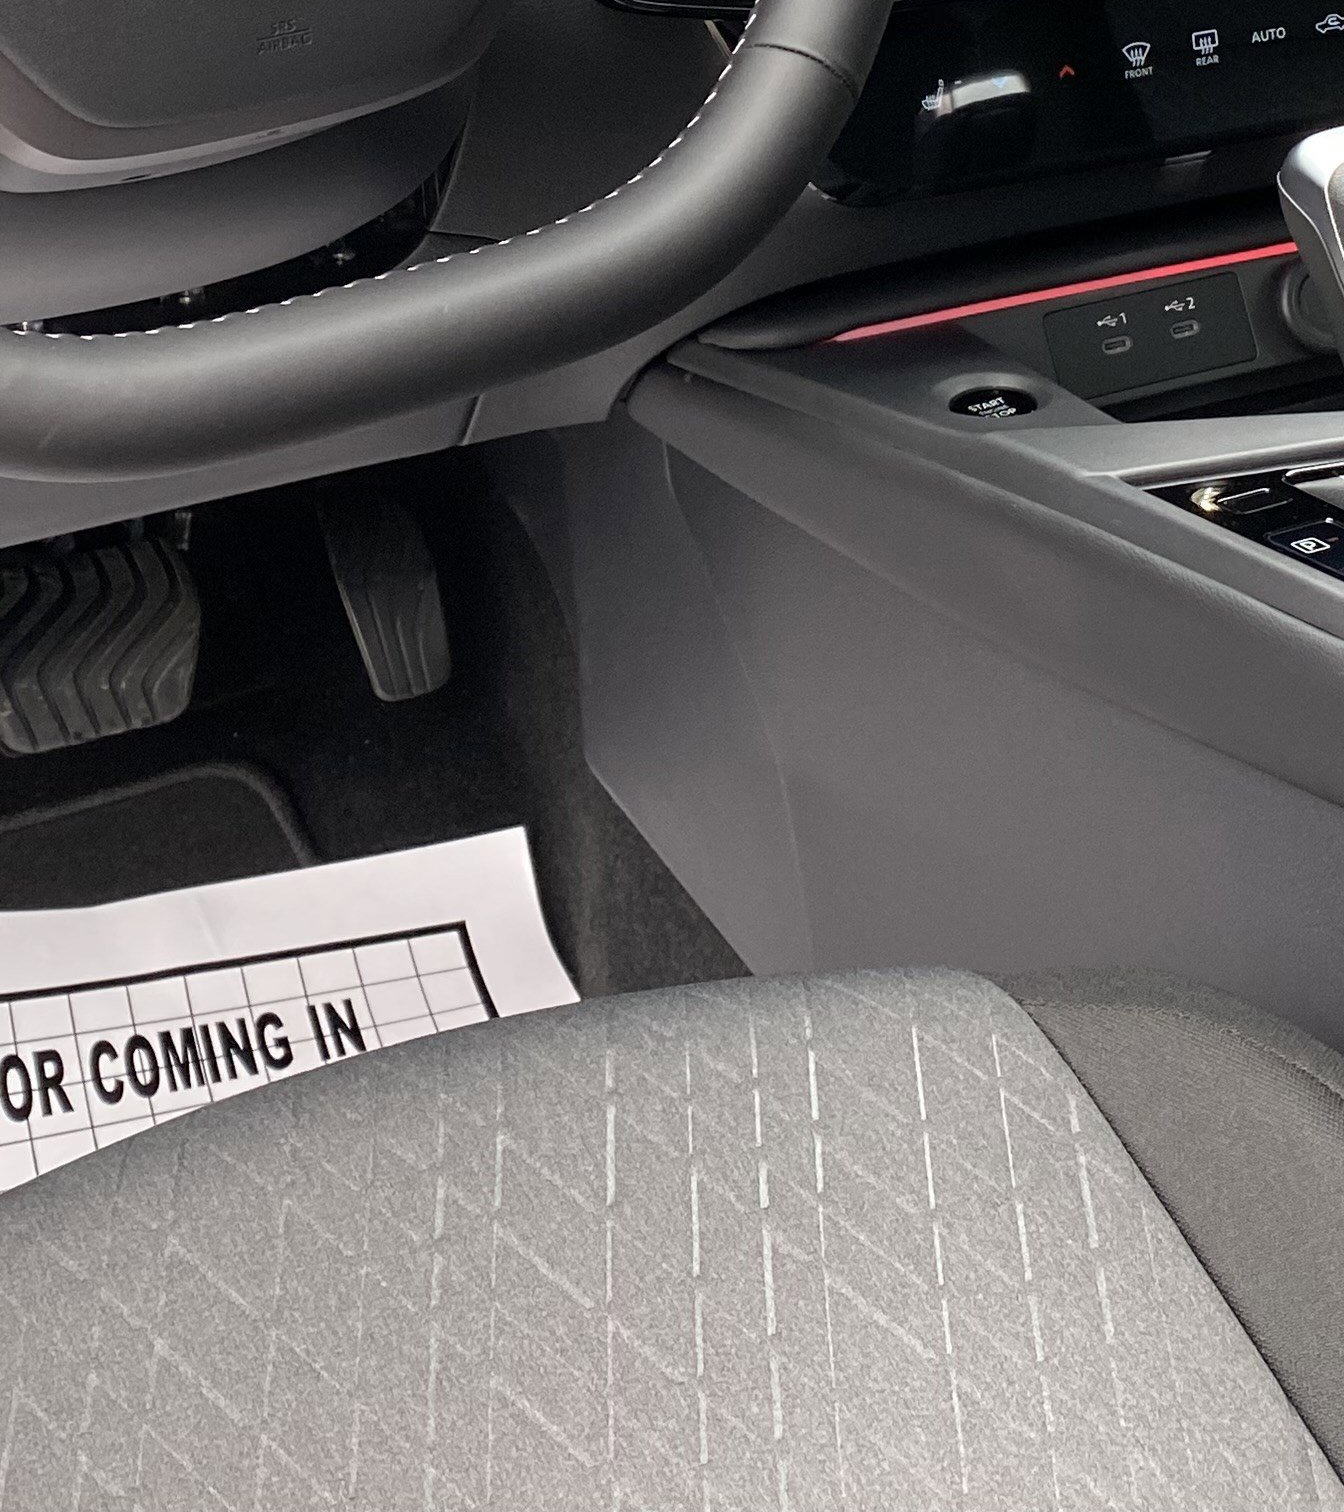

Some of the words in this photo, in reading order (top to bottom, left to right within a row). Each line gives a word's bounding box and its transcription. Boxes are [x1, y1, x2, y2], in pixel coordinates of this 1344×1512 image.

[1251, 26, 1287, 44] AUTO
[1195, 54, 1220, 67] REAR
[1124, 66, 1154, 80] FRONT
[1186, 296, 1197, 310] 2
[967, 396, 1006, 413] START
[88, 1011, 294, 1106] COMING
[307, 997, 368, 1062] IN
